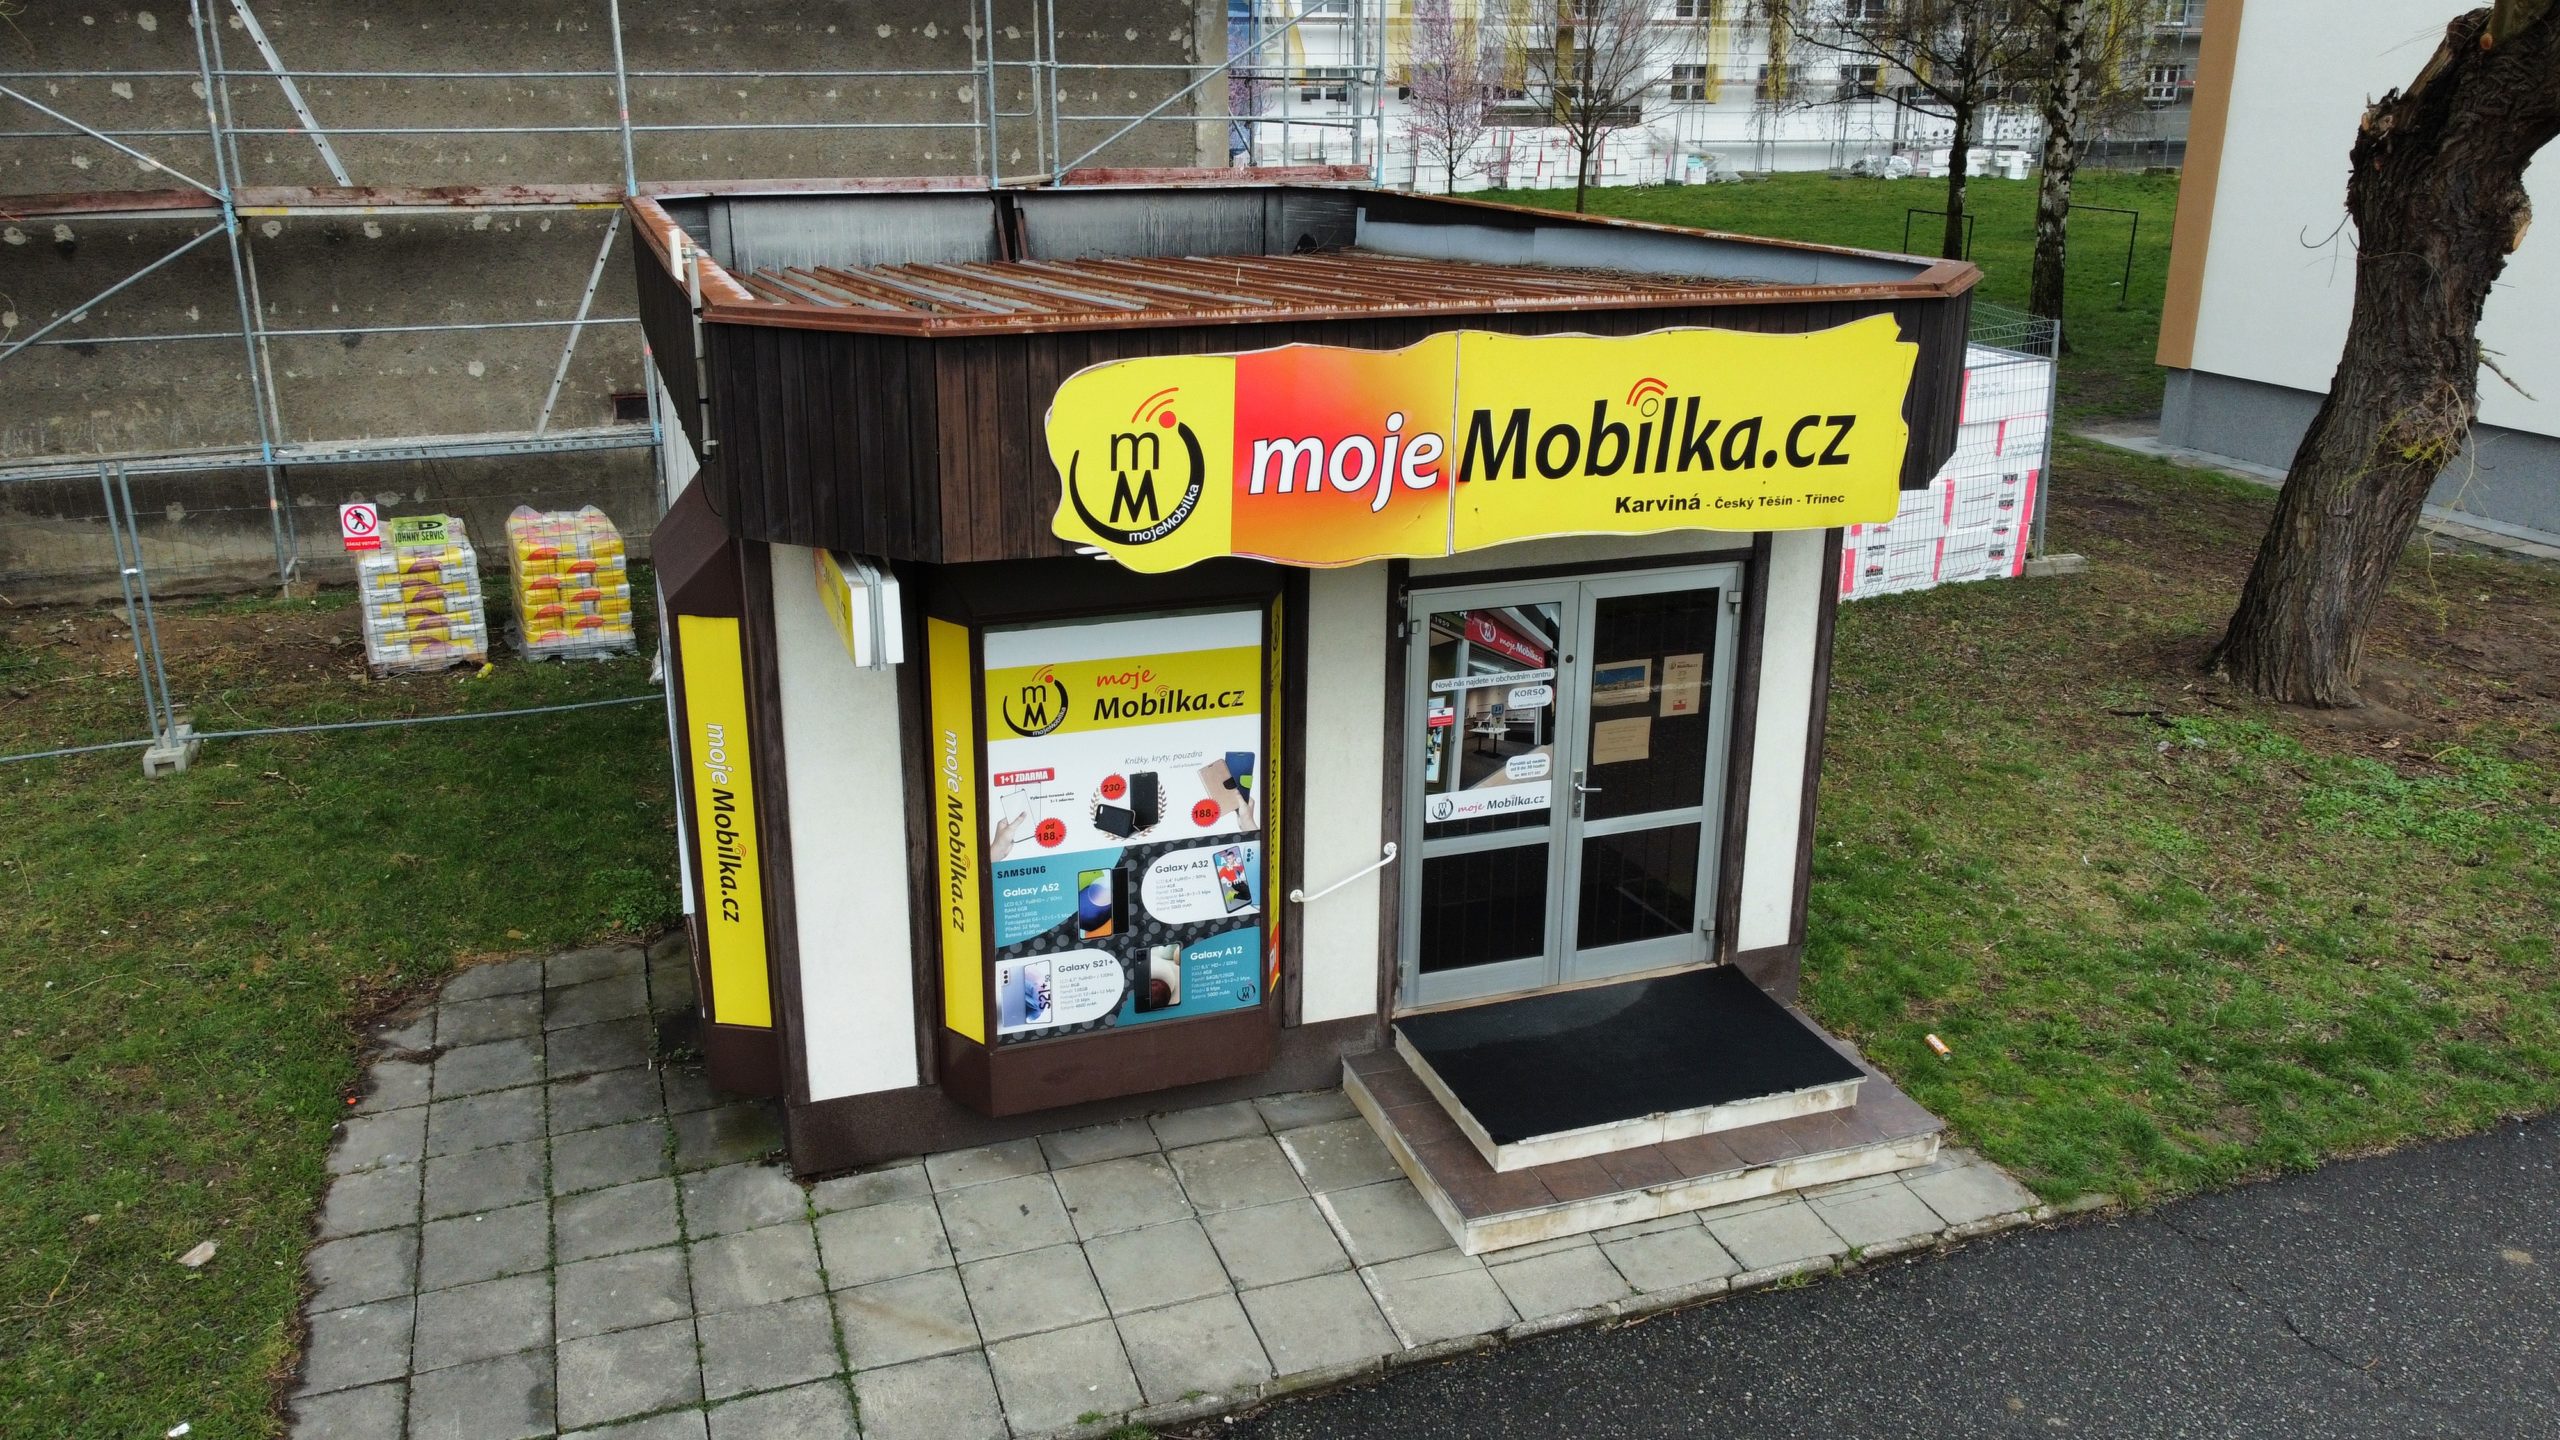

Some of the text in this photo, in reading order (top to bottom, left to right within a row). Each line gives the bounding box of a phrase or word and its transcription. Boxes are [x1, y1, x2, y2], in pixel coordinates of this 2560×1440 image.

[1249, 396, 1856, 513] moje Mobilka.cz
[1615, 493, 1701, 514] Karviná
[1714, 496, 1755, 511] Český
[1758, 494, 1793, 508] Těšín
[1805, 493, 1845, 505] Třinec
[1128, 484, 1200, 542] mojeMobilka
[395, 530, 445, 543] JOHNNY SERVIS
[1096, 665, 1157, 690] moje
[1466, 678, 1489, 687] najdete
[1496, 674, 1531, 683] obchodním
[1514, 688, 1546, 698] KORSO
[1094, 688, 1245, 721] Mobilka.cz
[1173, 751, 1203, 761] pouzdra
[1000, 771, 1048, 784] 1+1 ZDARMA
[1458, 795, 1544, 813] moje Mobilka.cz
[707, 722, 742, 924] moje Mobilka.cz
[1045, 822, 1055, 831] od
[945, 729, 969, 932] moje Mobilka.cz
[997, 866, 1046, 878] SAMSUNG
[1155, 860, 1209, 874] Galaxy A32
[1003, 883, 1060, 898] Galaxy A52
[1190, 946, 1243, 960] Galaxy A12
[1058, 960, 1114, 972] Galaxy S21+
[1039, 983, 1051, 1009] S21+
